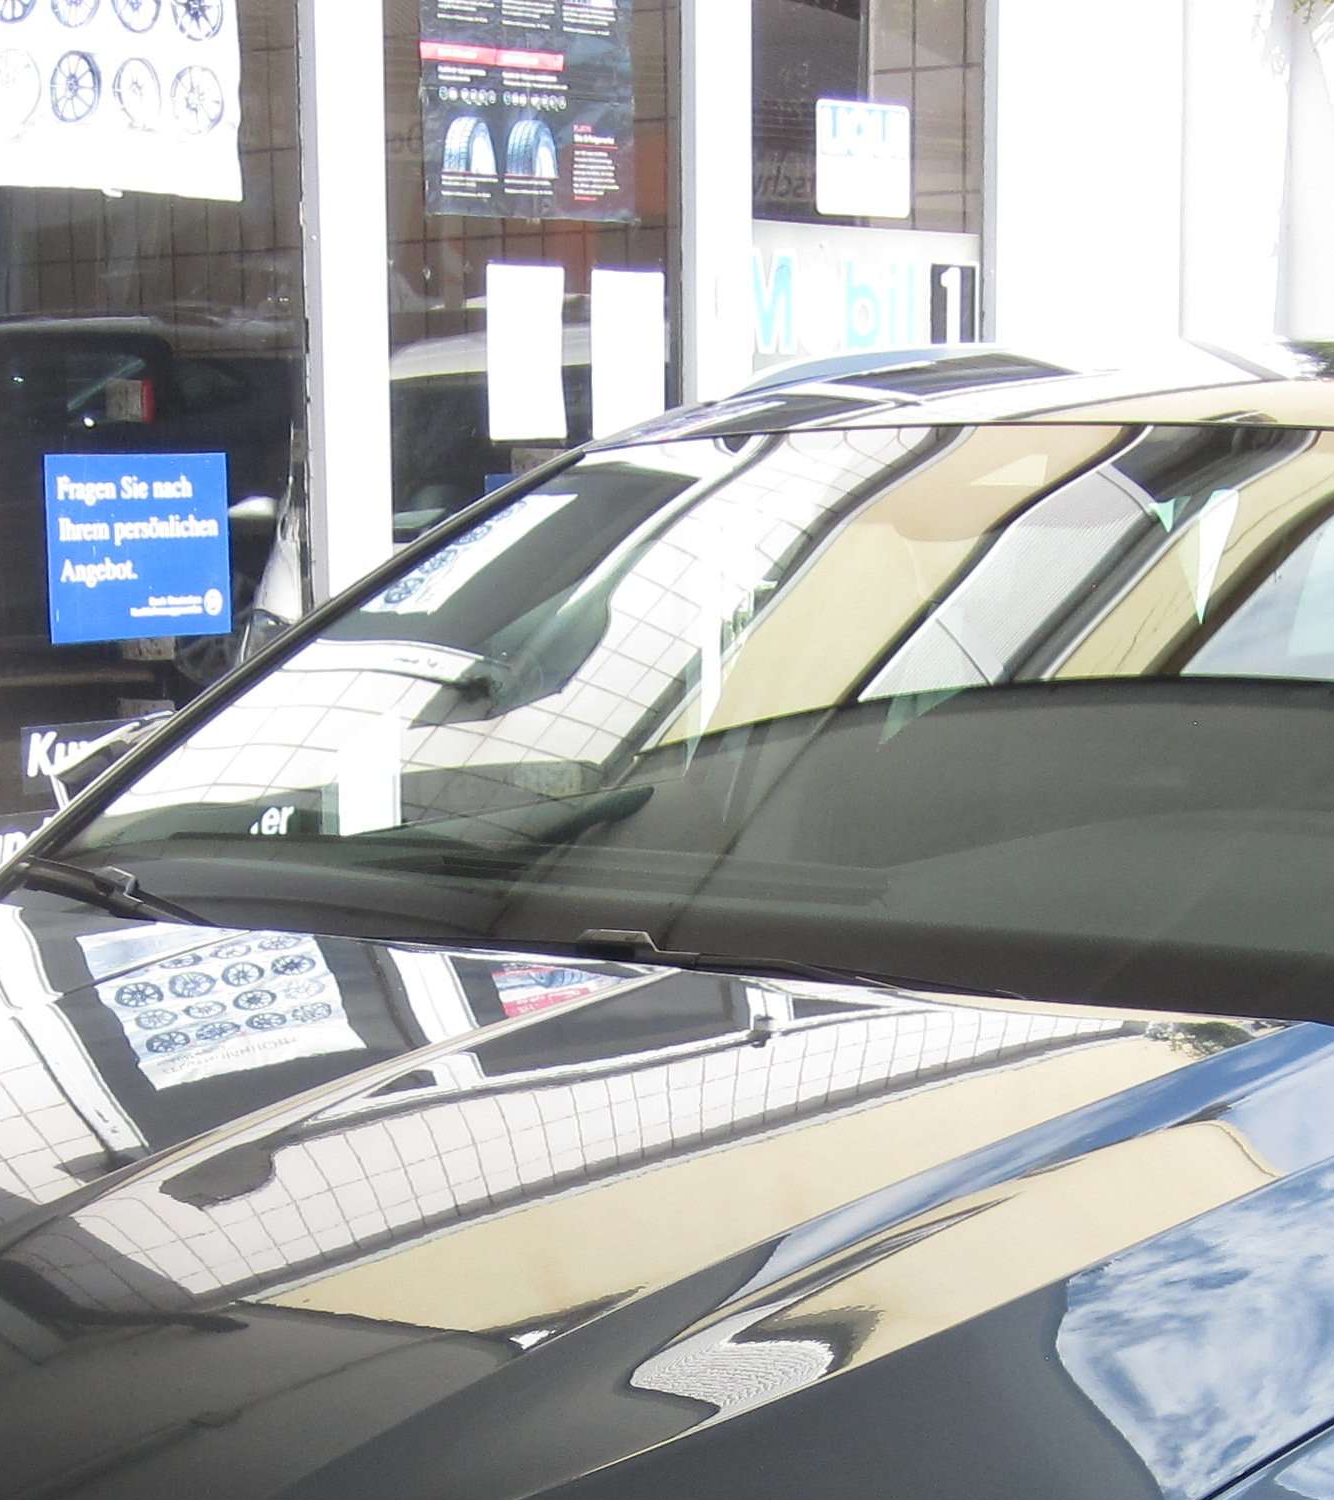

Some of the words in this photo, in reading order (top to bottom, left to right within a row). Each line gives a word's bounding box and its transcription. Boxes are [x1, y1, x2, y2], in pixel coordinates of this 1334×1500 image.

[56, 475, 117, 506] Fragen
[120, 475, 149, 499] Sie
[152, 474, 193, 498] nach
[58, 516, 110, 541] Ihrem
[113, 514, 219, 546] persönlichen
[60, 556, 139, 588] Angebot.
